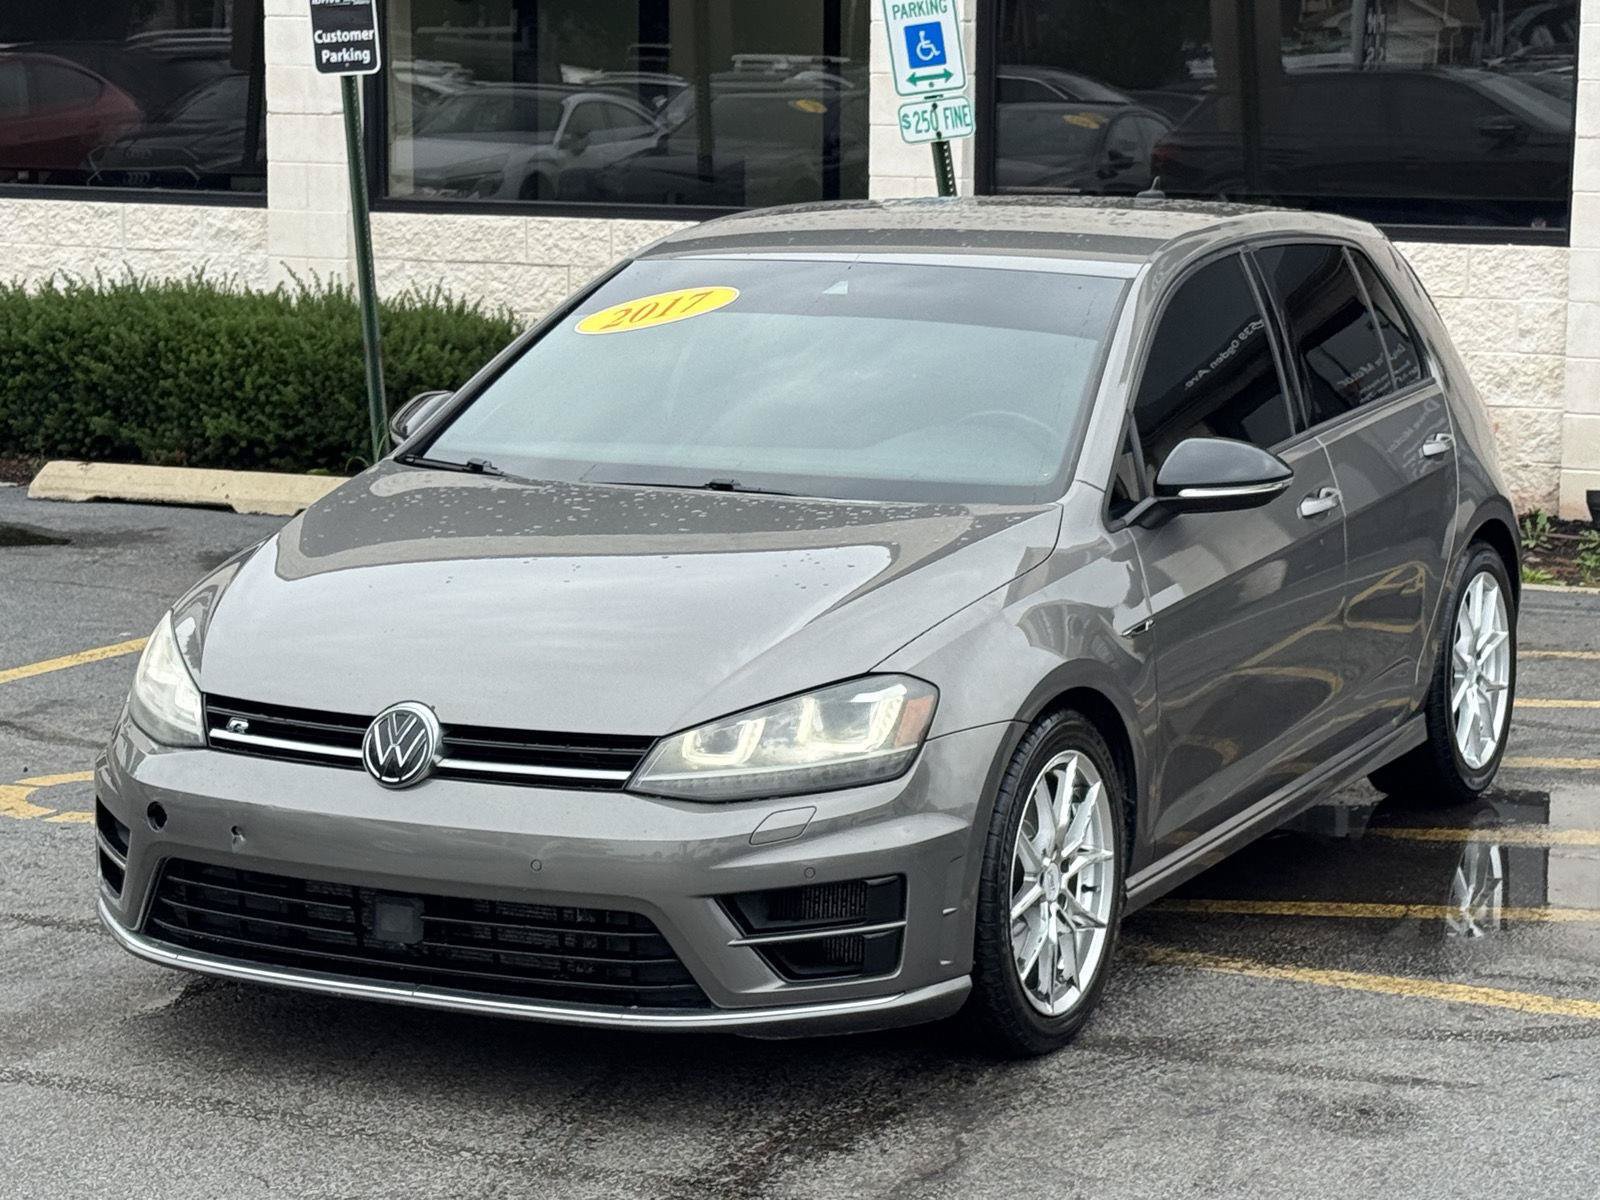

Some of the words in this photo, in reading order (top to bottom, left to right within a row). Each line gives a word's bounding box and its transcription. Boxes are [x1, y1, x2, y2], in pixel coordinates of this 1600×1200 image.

[892, 0, 948, 20] PARKING
[314, 29, 375, 44] Customer
[321, 47, 371, 64] Parking
[901, 108, 939, 134] $250
[943, 104, 972, 130] FINE
[600, 291, 714, 330] 2017
